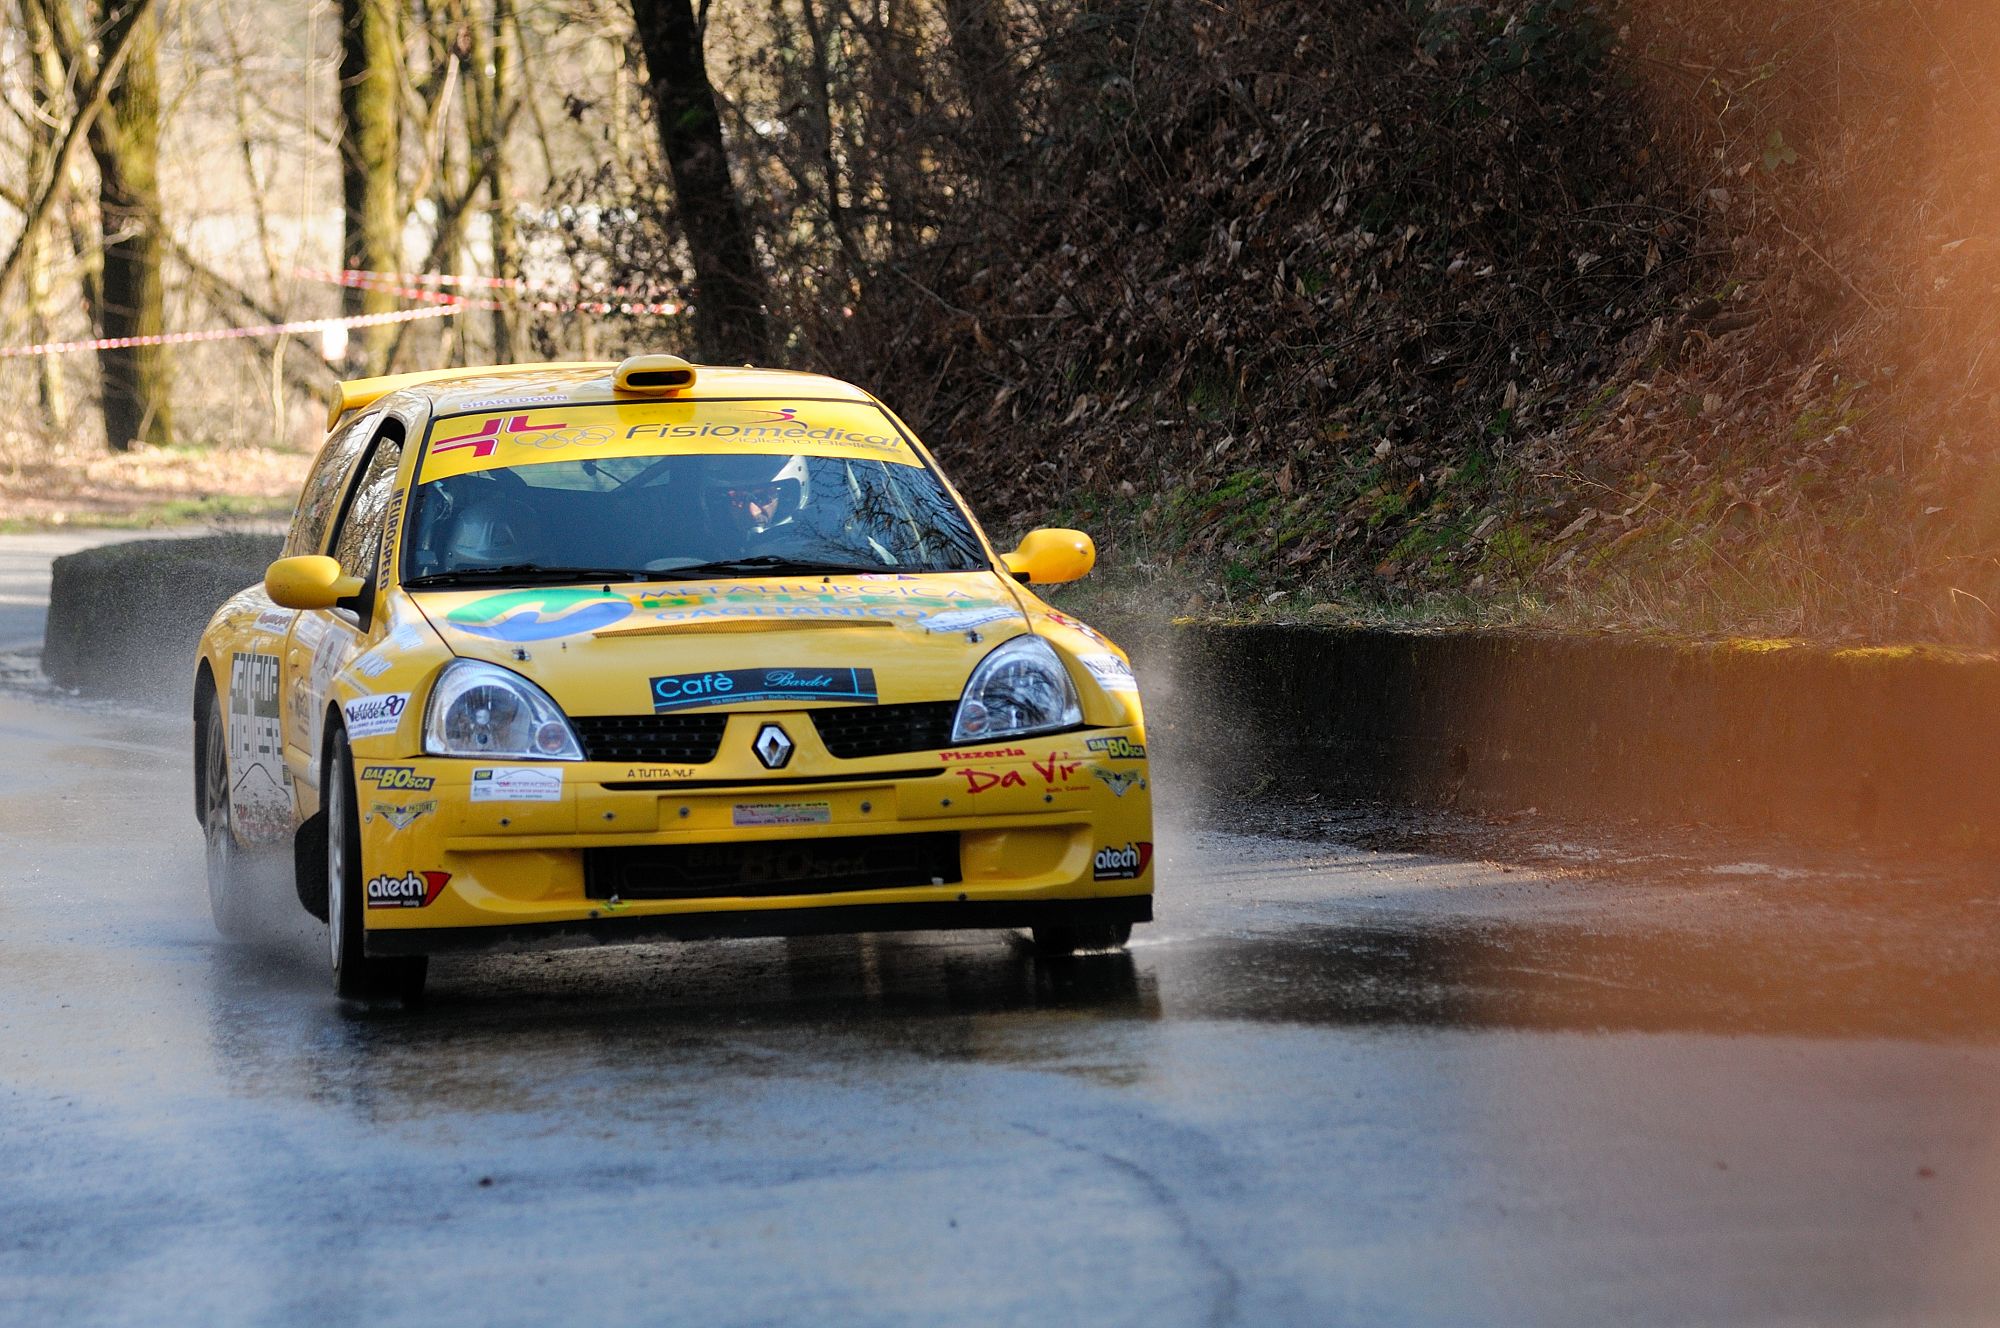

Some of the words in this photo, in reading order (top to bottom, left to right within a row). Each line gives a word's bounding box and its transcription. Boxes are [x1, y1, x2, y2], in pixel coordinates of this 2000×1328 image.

[462, 395, 568, 408] SHAKEDOWN
[626, 422, 900, 447] Fisiomedical
[640, 585, 975, 599] METALLURGICA
[656, 673, 734, 697] Cafè
[764, 670, 832, 688] Bardot
[939, 748, 1026, 761] Pizzeria
[628, 769, 635, 778] A
[637, 768, 671, 778] TUTTA
[956, 768, 1026, 793] Da
[1095, 844, 1137, 869] atech
[368, 872, 423, 897] atech
